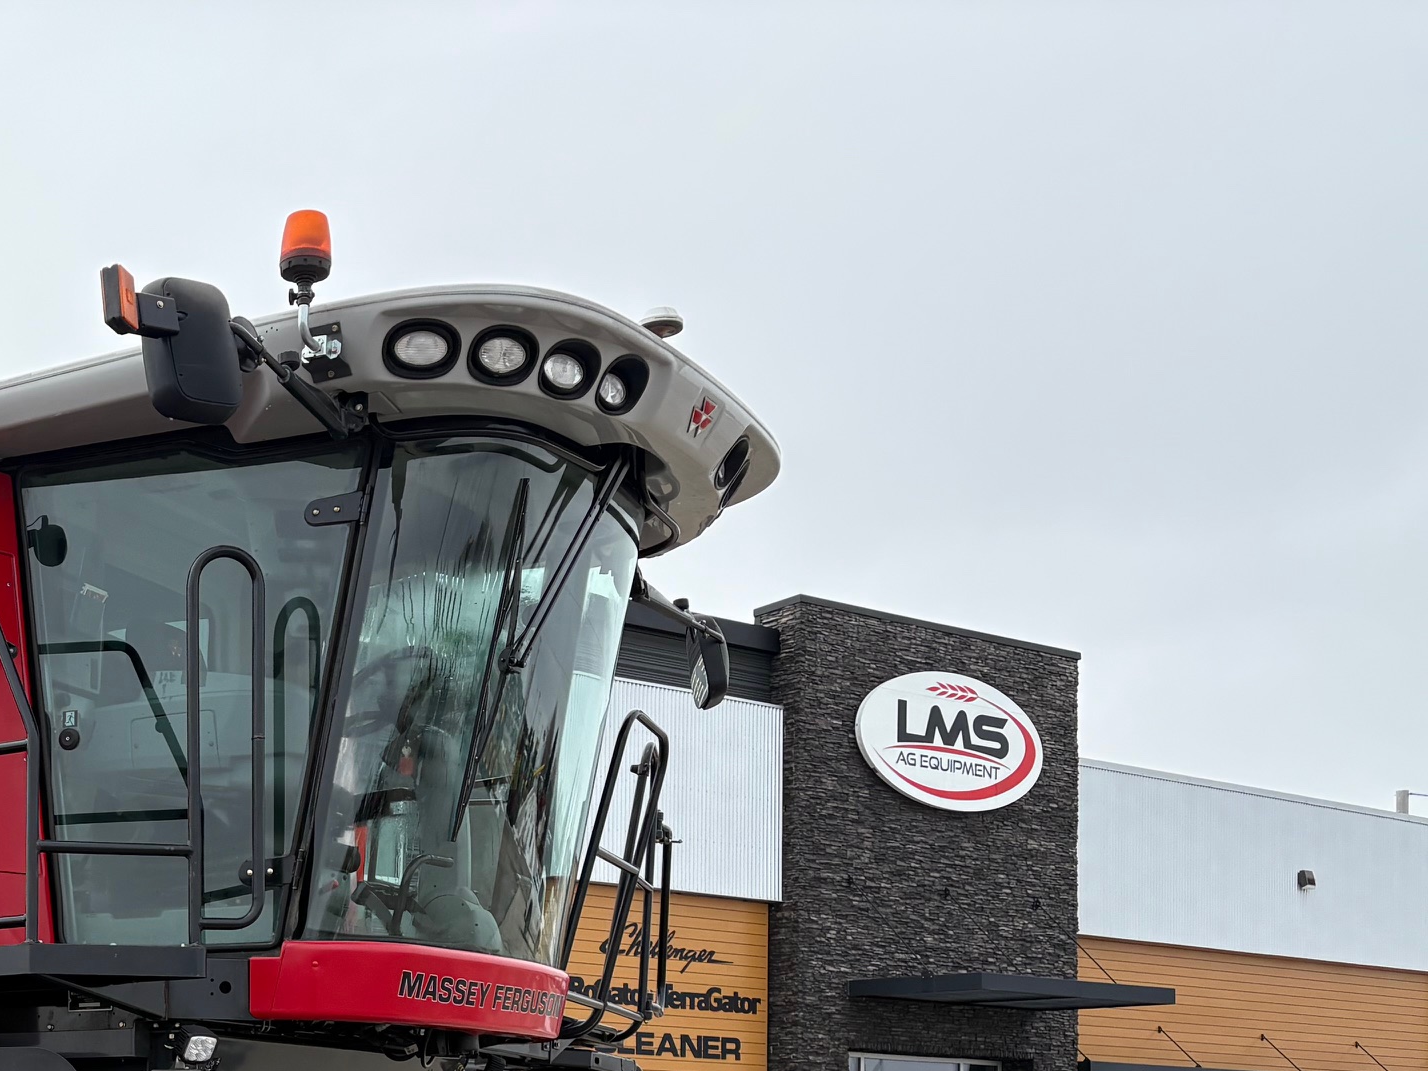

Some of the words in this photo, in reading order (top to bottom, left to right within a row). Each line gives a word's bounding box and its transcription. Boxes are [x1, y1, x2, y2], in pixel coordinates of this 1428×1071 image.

[897, 699, 1009, 759] LMS
[896, 751, 916, 766] AG
[920, 754, 1000, 780] EQUIPMENT
[397, 970, 491, 1009] MASSEY
[492, 984, 564, 1018] FERGUSON
[595, 1032, 741, 1061] LEANER
